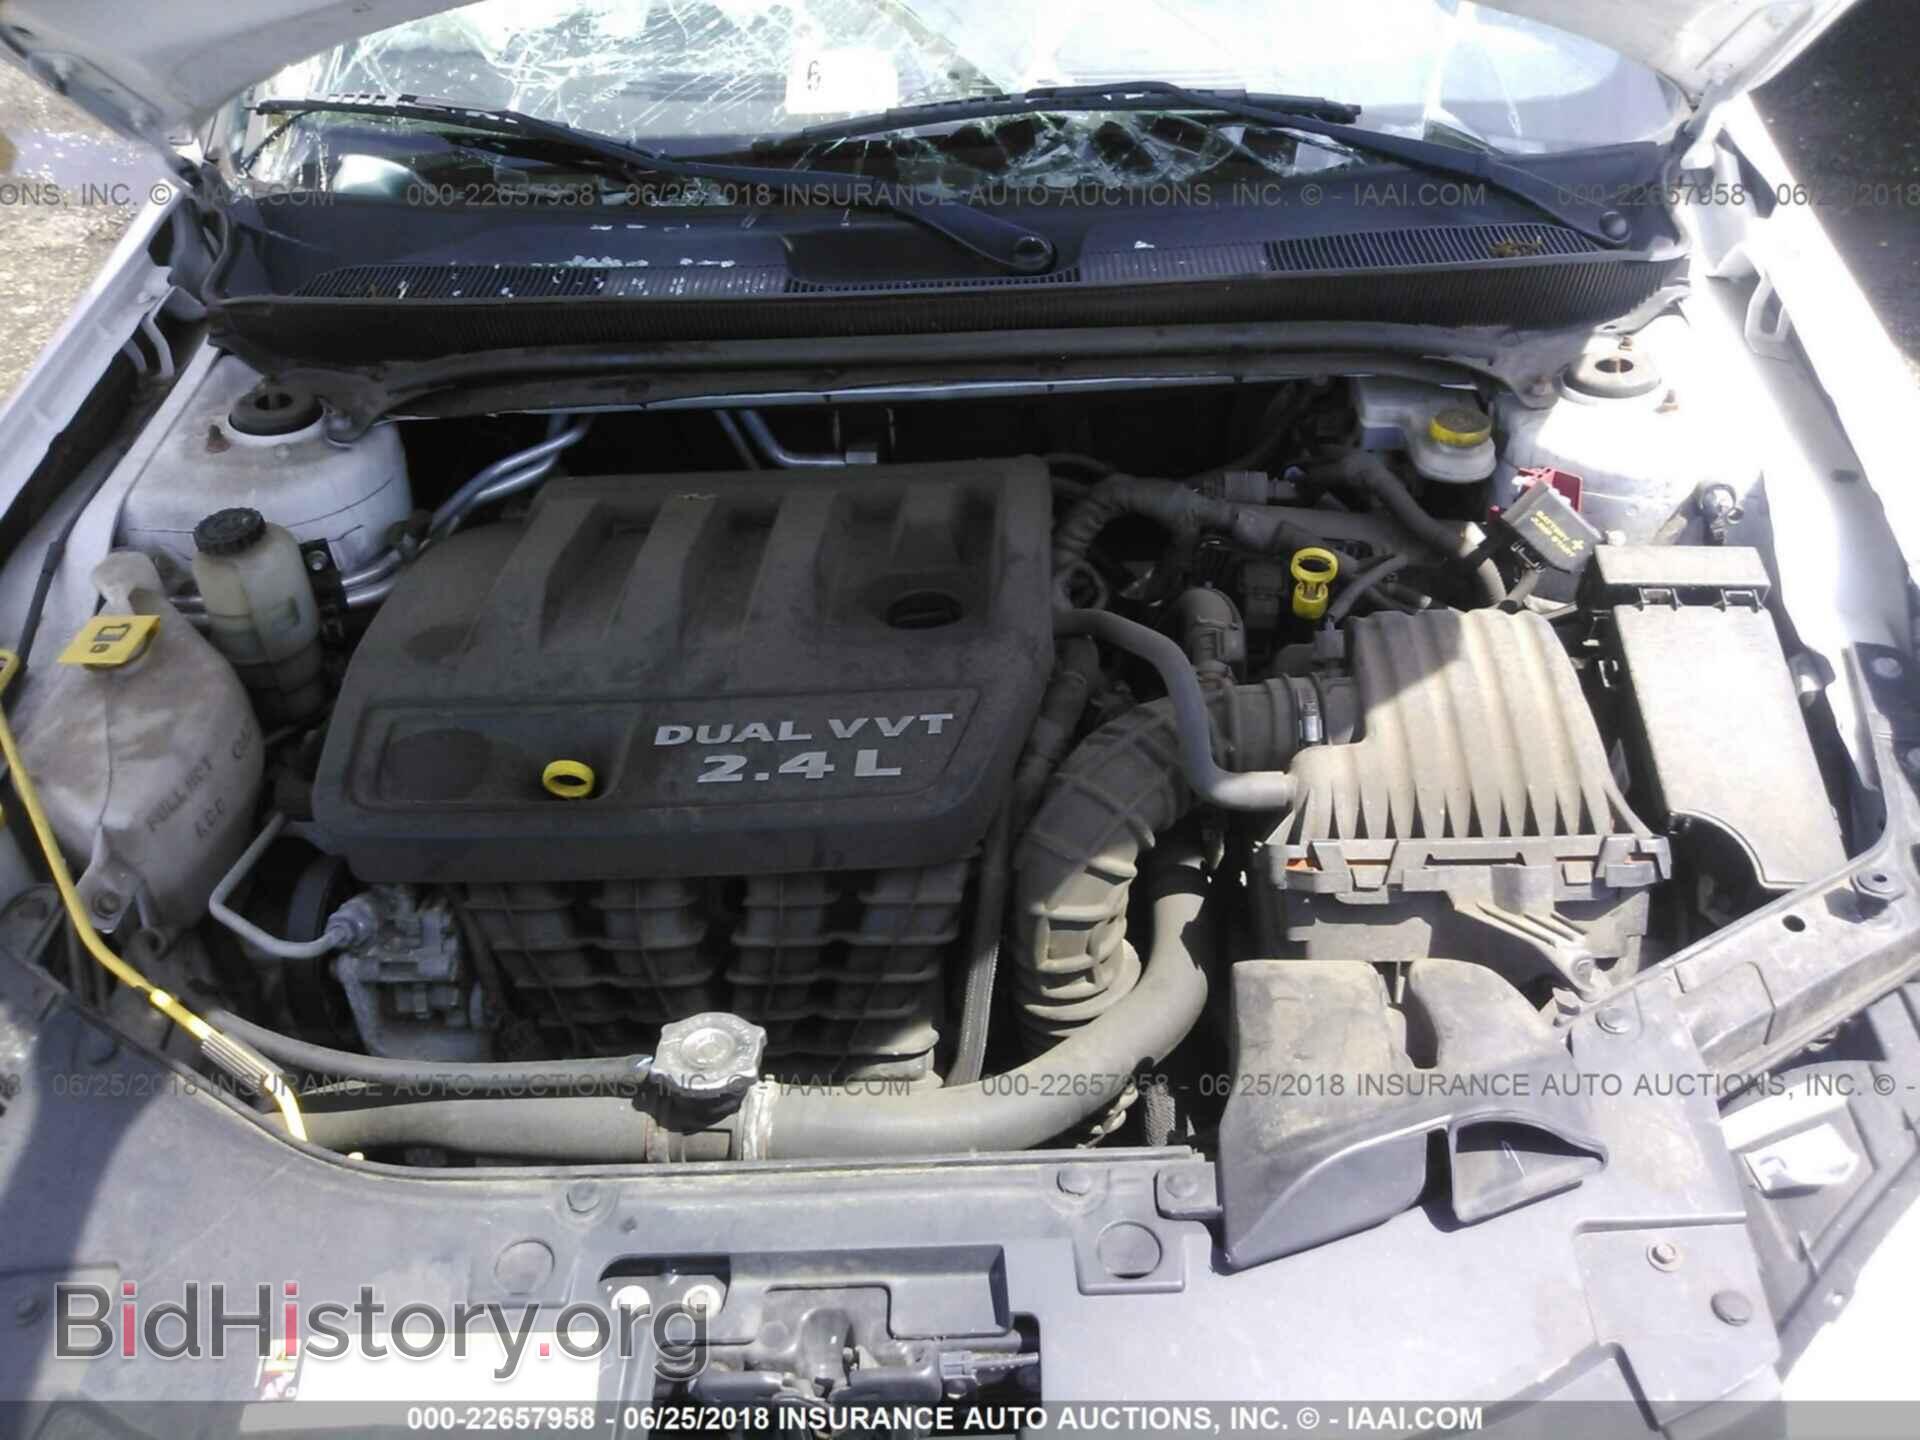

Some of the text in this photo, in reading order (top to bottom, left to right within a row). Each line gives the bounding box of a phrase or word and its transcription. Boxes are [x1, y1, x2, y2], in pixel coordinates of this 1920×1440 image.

[654, 713, 953, 746] DUAL VVT
[697, 749, 901, 783] 2.4 L
